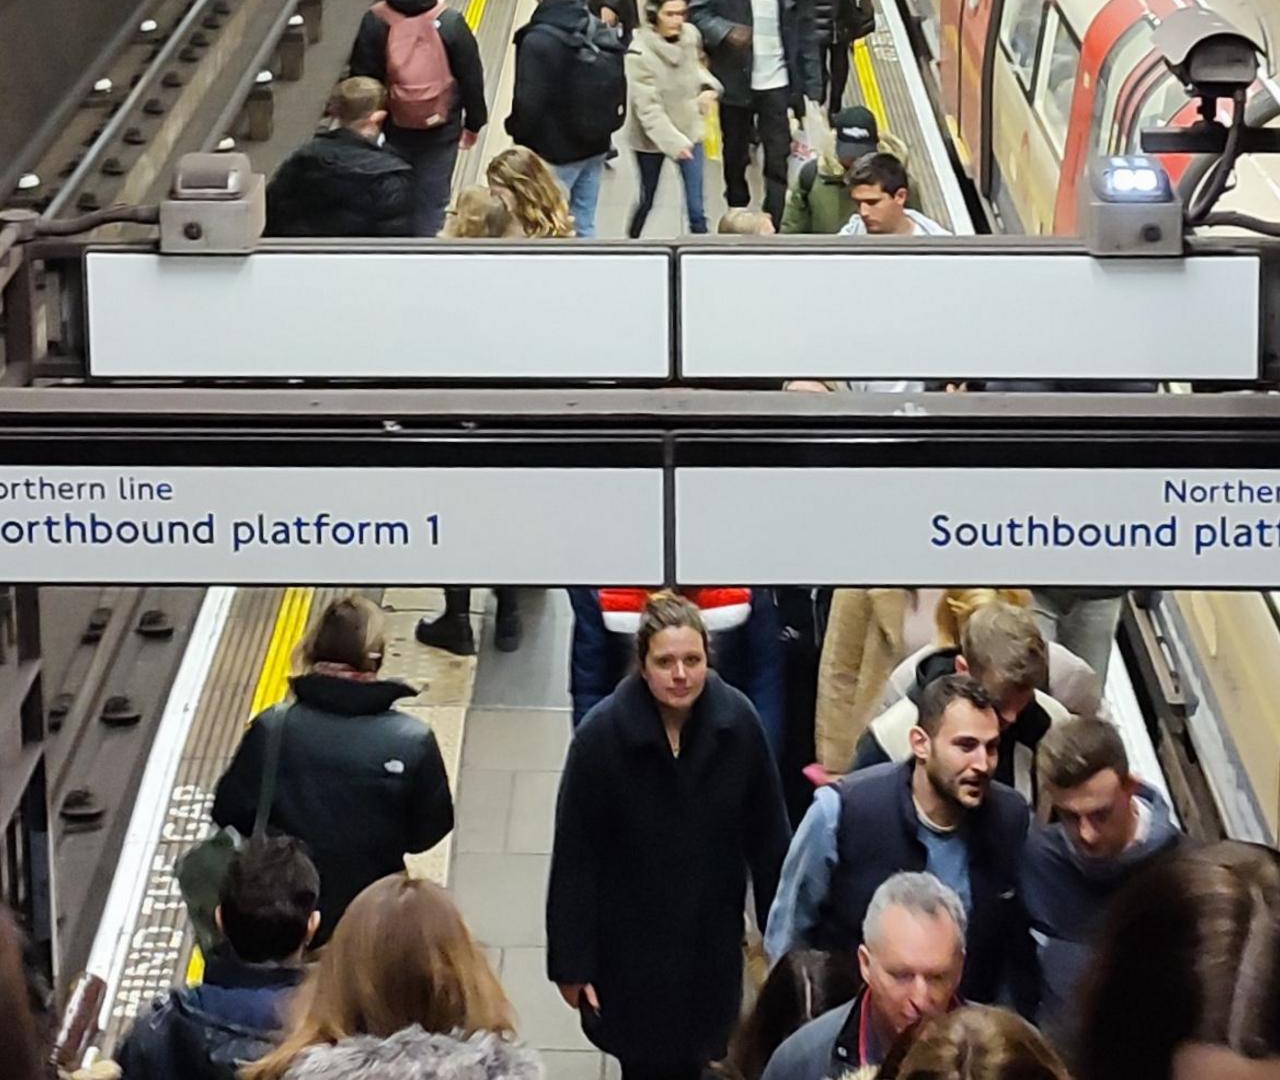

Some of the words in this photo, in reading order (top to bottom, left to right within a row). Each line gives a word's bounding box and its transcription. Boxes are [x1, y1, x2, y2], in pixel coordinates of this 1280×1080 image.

[119, 476, 174, 501] line
[233, 513, 410, 552] platform
[426, 514, 440, 545] 1
[930, 514, 1177, 548] Southbound
[162, 784, 217, 842] GAP
